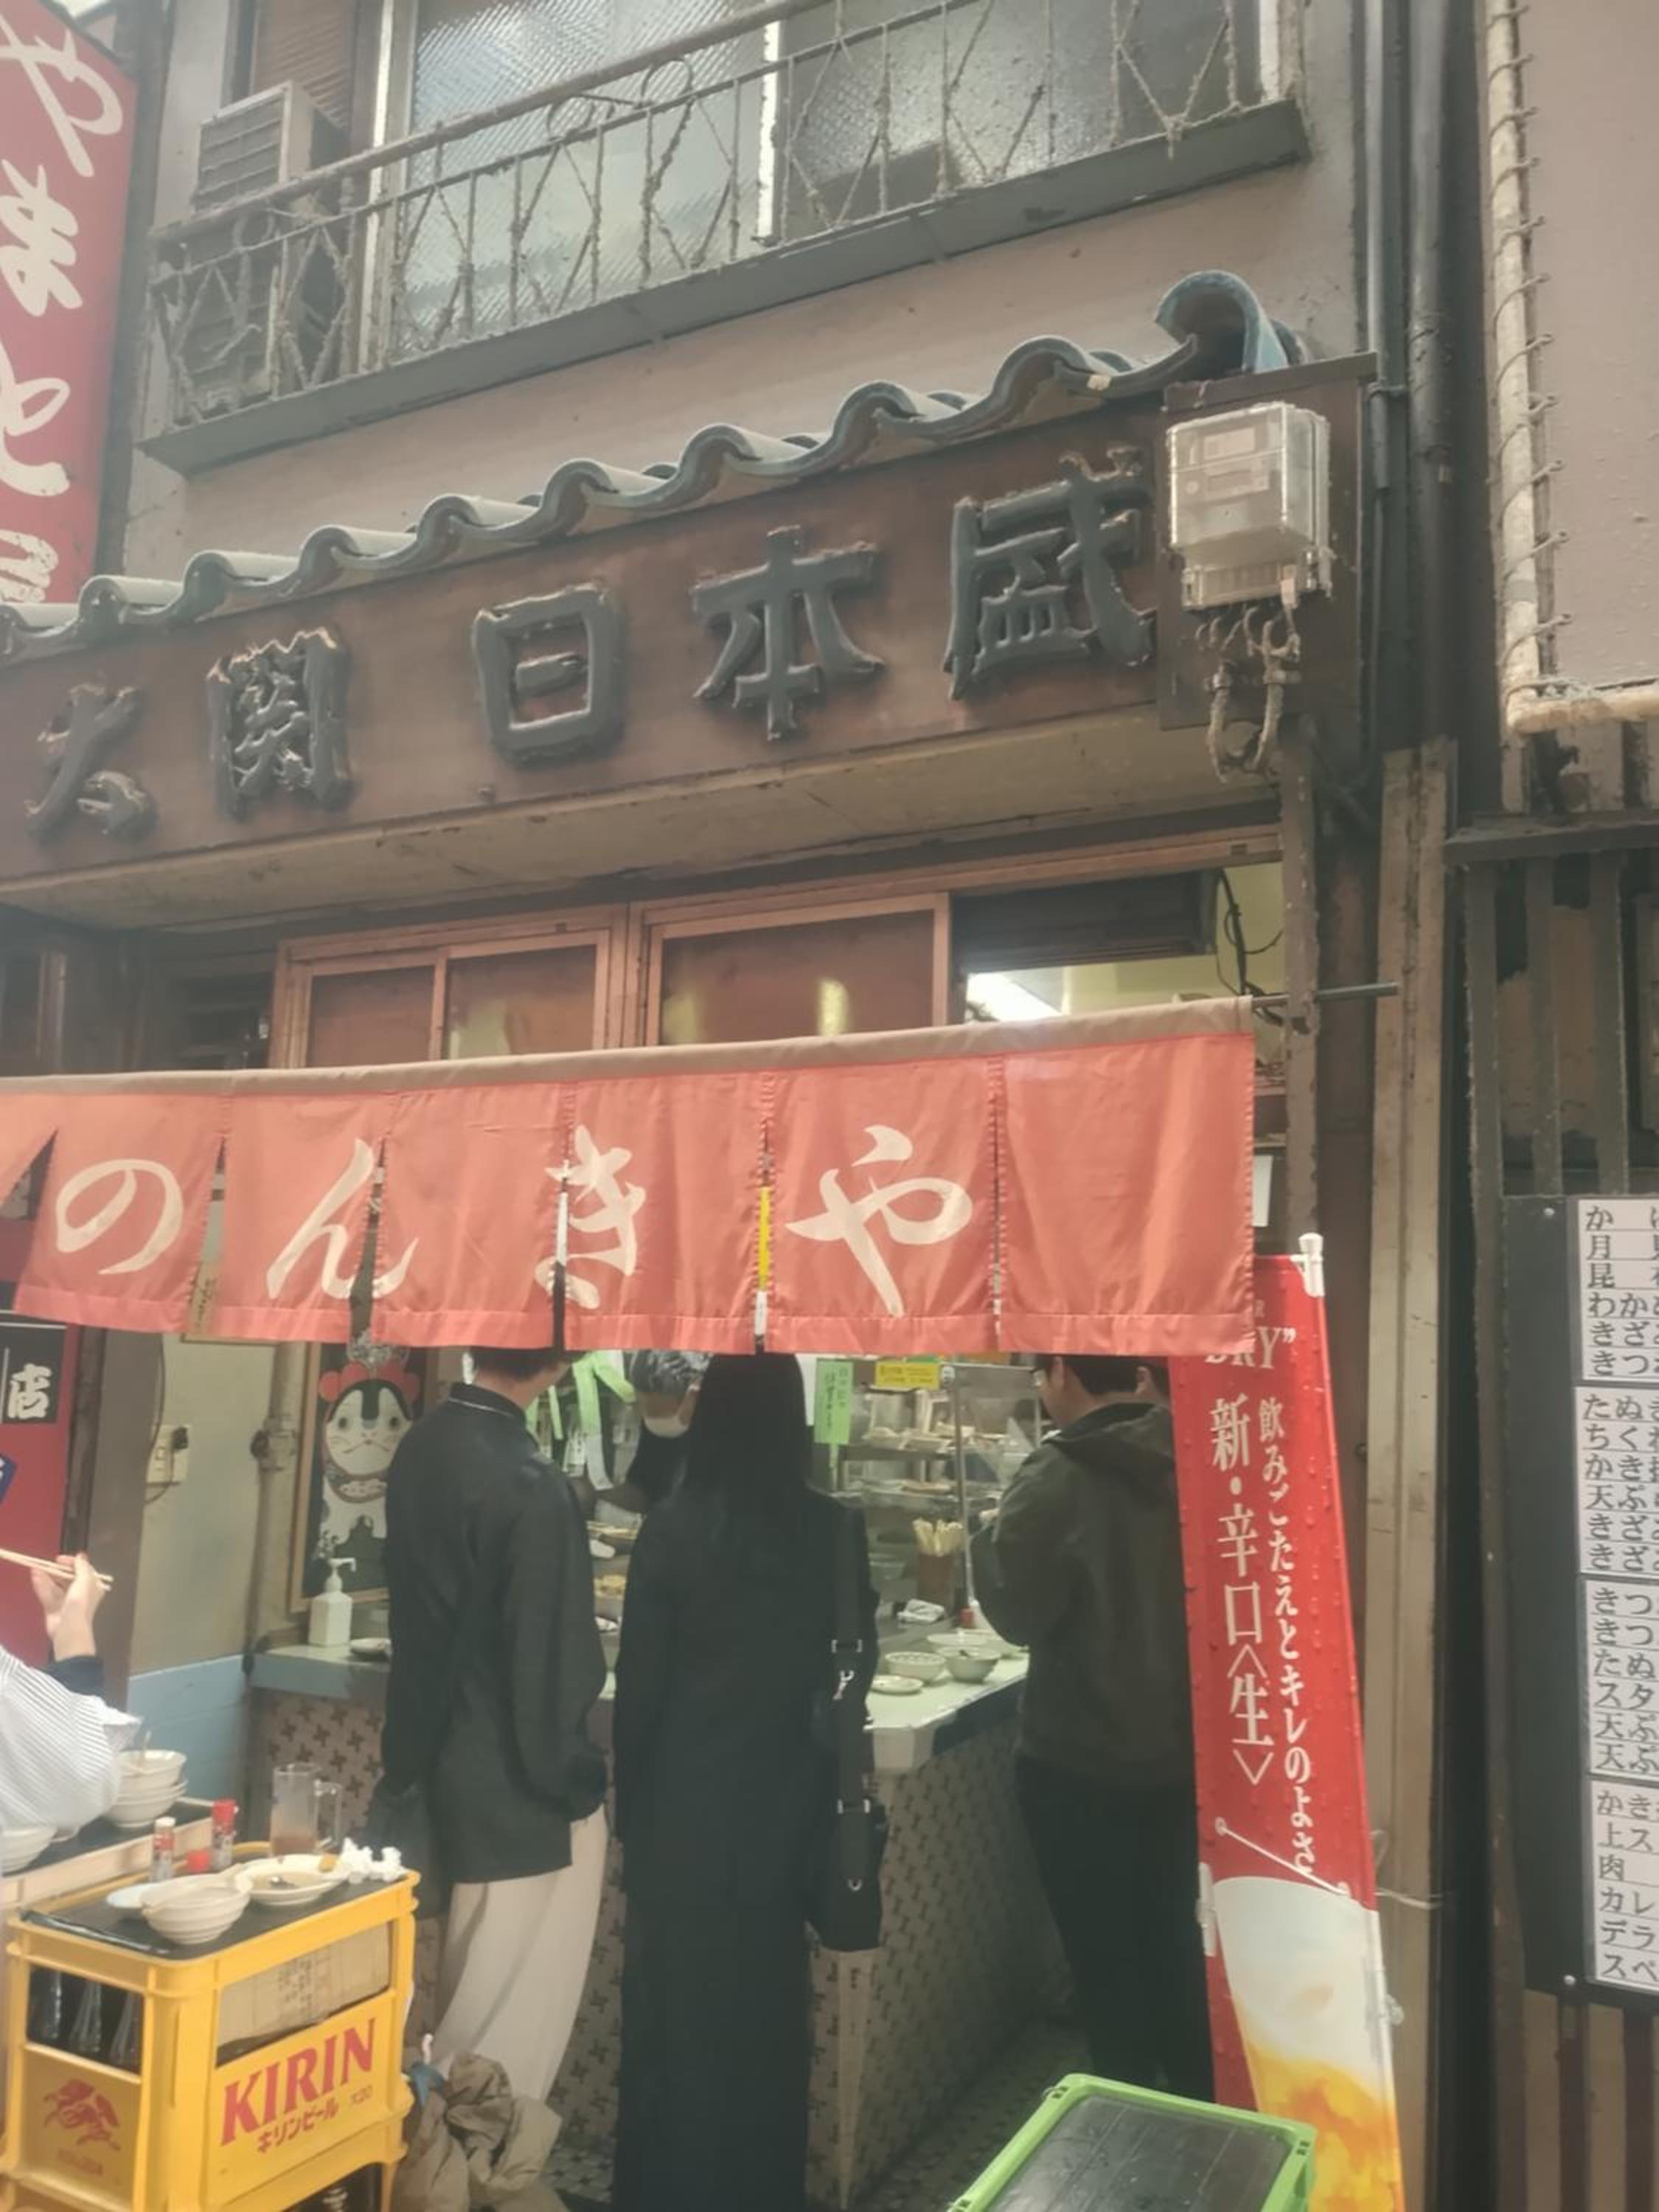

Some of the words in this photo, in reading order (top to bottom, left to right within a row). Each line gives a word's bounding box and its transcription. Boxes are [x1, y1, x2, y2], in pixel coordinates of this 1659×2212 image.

[55, 1124, 973, 1318] のんきや
[1585, 1205, 1659, 1231] か
[1592, 1587, 1659, 1615] きつ
[1258, 1396, 1317, 1874] 飲みごたえとキレのよさ
[1593, 1618, 1659, 1645] きつ
[1597, 1790, 1659, 1820] かき
[221, 2017, 376, 2147] KIRIN
[257, 2097, 339, 2154] キリンビール
